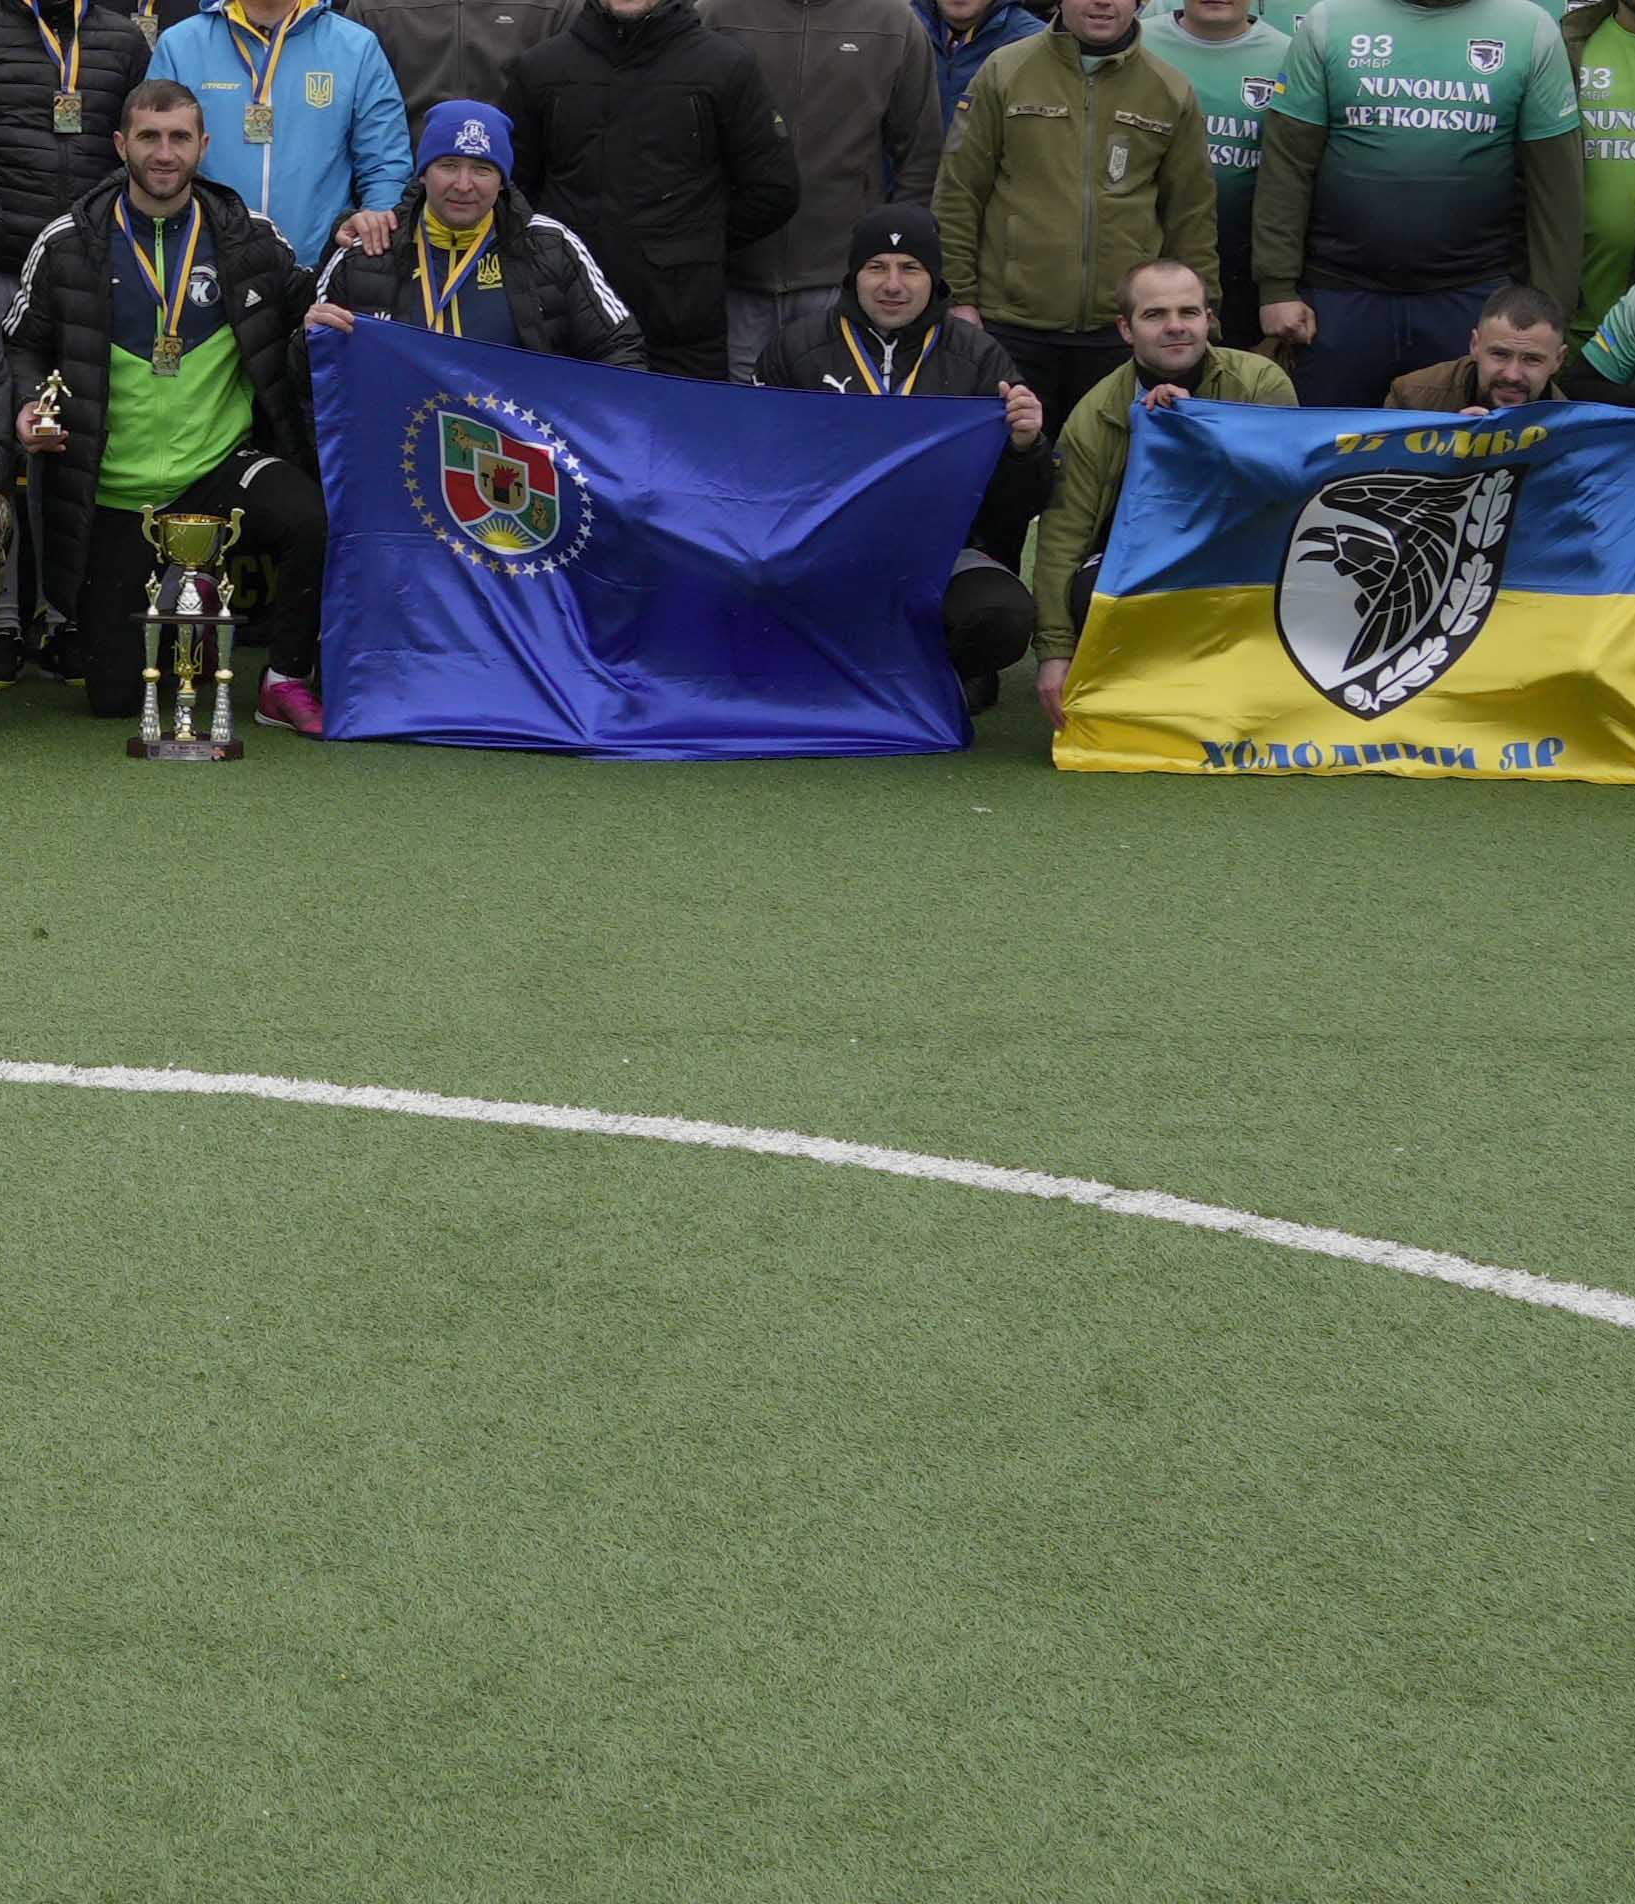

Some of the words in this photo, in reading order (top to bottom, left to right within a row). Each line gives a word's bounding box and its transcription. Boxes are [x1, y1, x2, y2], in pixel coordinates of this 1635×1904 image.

[1350, 34, 1393, 58] 93
[1347, 58, 1391, 69] ОМБР
[1356, 77, 1491, 105] NUNQUAM
[1403, 425, 1549, 460] ОМБР
[1200, 736, 1479, 771] ХОЛОДНИЙ
[1499, 736, 1566, 770] ЯР
